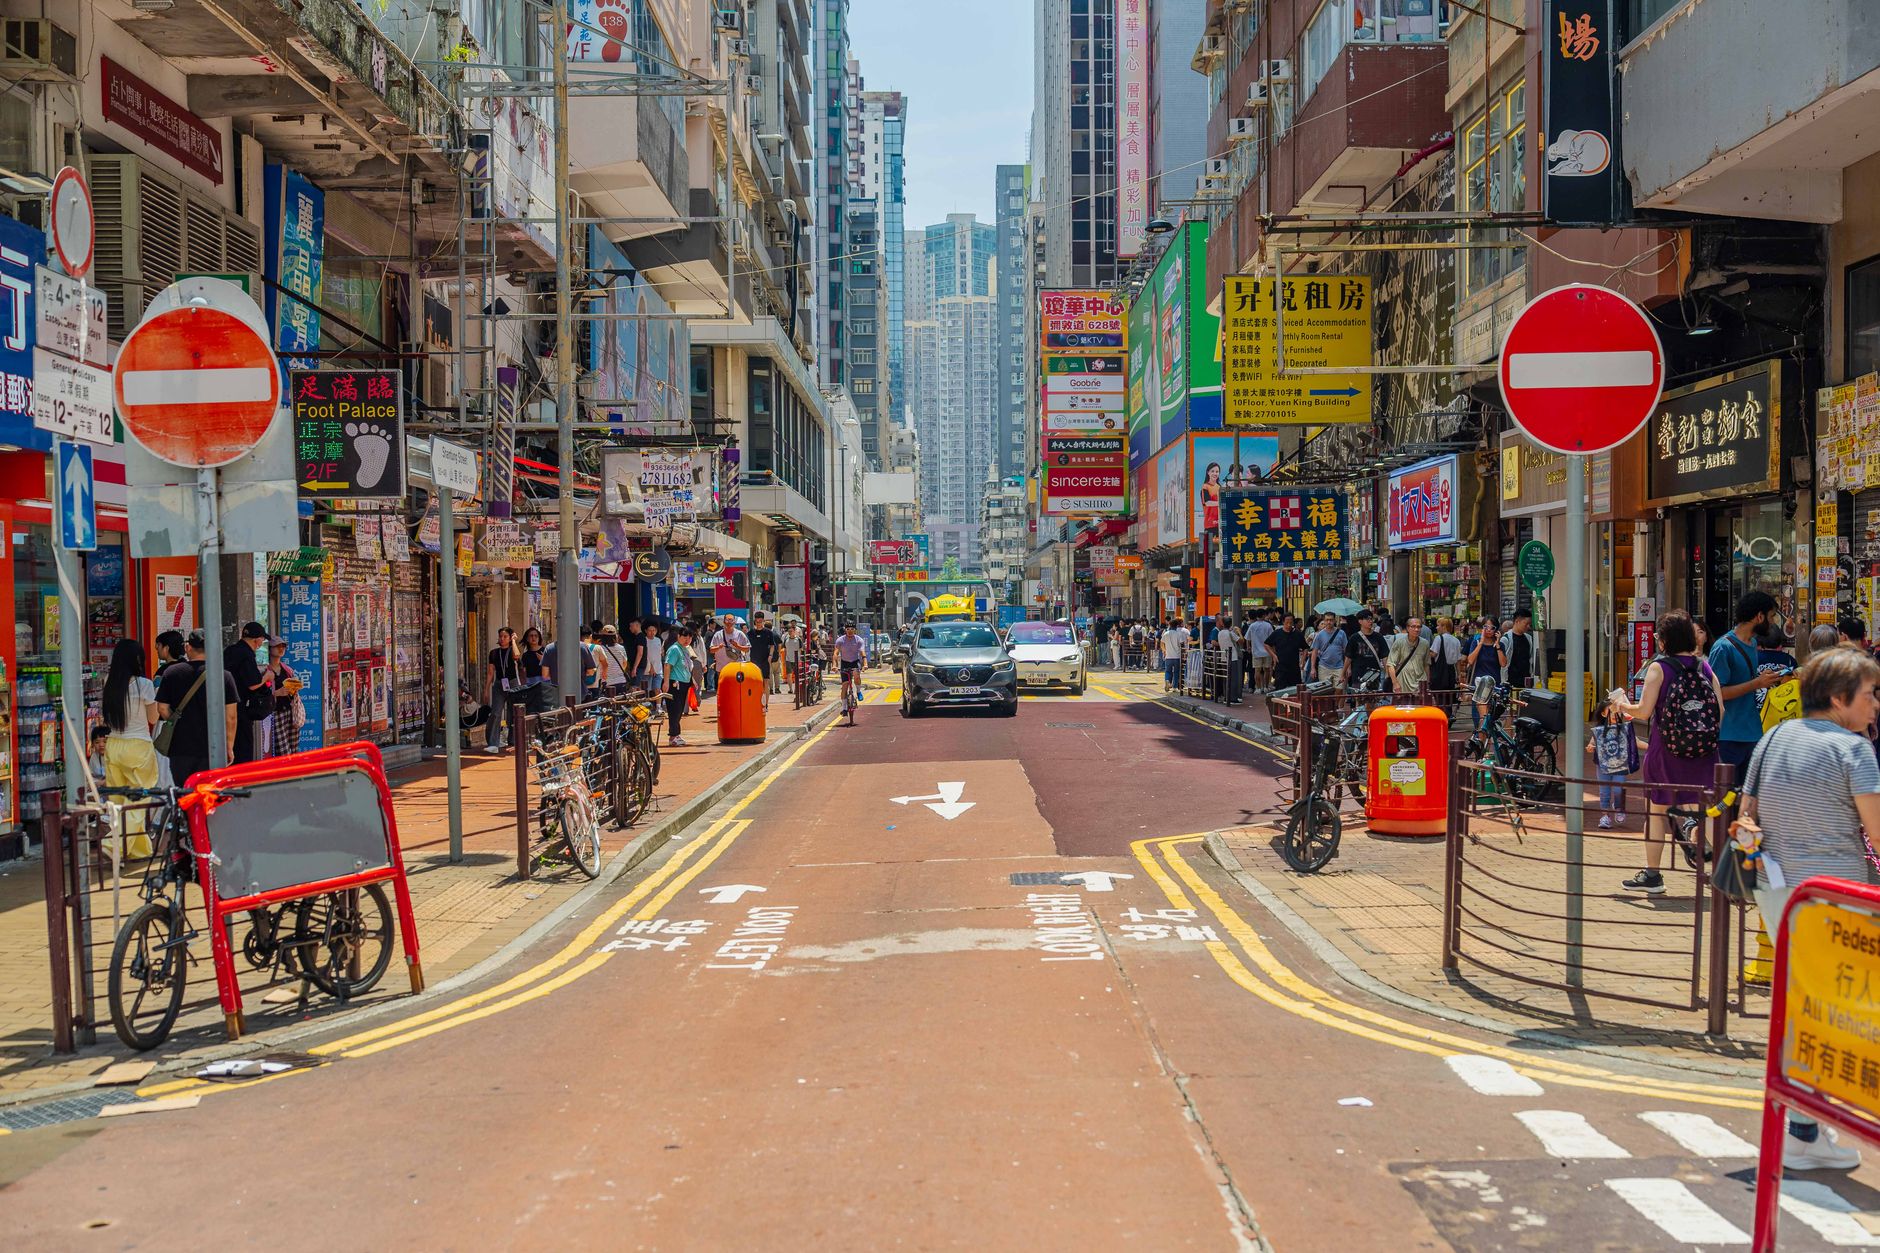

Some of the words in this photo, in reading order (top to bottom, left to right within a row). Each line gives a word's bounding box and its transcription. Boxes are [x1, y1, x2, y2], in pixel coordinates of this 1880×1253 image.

[602, 16, 624, 27] 138
[1122, 226, 1144, 236] FUN
[92, 298, 104, 322] 12
[1045, 296, 1126, 316] 瓊華中心
[1049, 320, 1084, 331] 彌敦道
[1088, 320, 1122, 331] 628號
[1232, 318, 1268, 328] 酒店式套房
[1307, 318, 1366, 327] Accommodation
[1272, 332, 1300, 342] Mnthly
[1290, 359, 1328, 367] Decorated
[1272, 373, 1286, 381] Free
[74, 404, 97, 416] midnight
[297, 403, 334, 418] Foot
[340, 403, 396, 418] Palace
[1293, 399, 1312, 407] King
[1314, 399, 1350, 407] Building
[100, 412, 110, 436] 12
[299, 422, 342, 438] 正宗
[300, 442, 344, 460] 按摩
[306, 464, 337, 479] 2/F
[642, 472, 692, 485] 27811682
[1052, 478, 1102, 486] sincere
[1074, 500, 1112, 508] SUSHIRO
[1401, 482, 1430, 526] ヤマト
[1232, 530, 1341, 551] 中西大藥房
[1015, 893, 1090, 924] RIGHT
[732, 906, 799, 936] LOOK
[1034, 924, 1105, 962] LOOK
[706, 937, 784, 970] LEFT
[1803, 995, 1822, 1022] All
